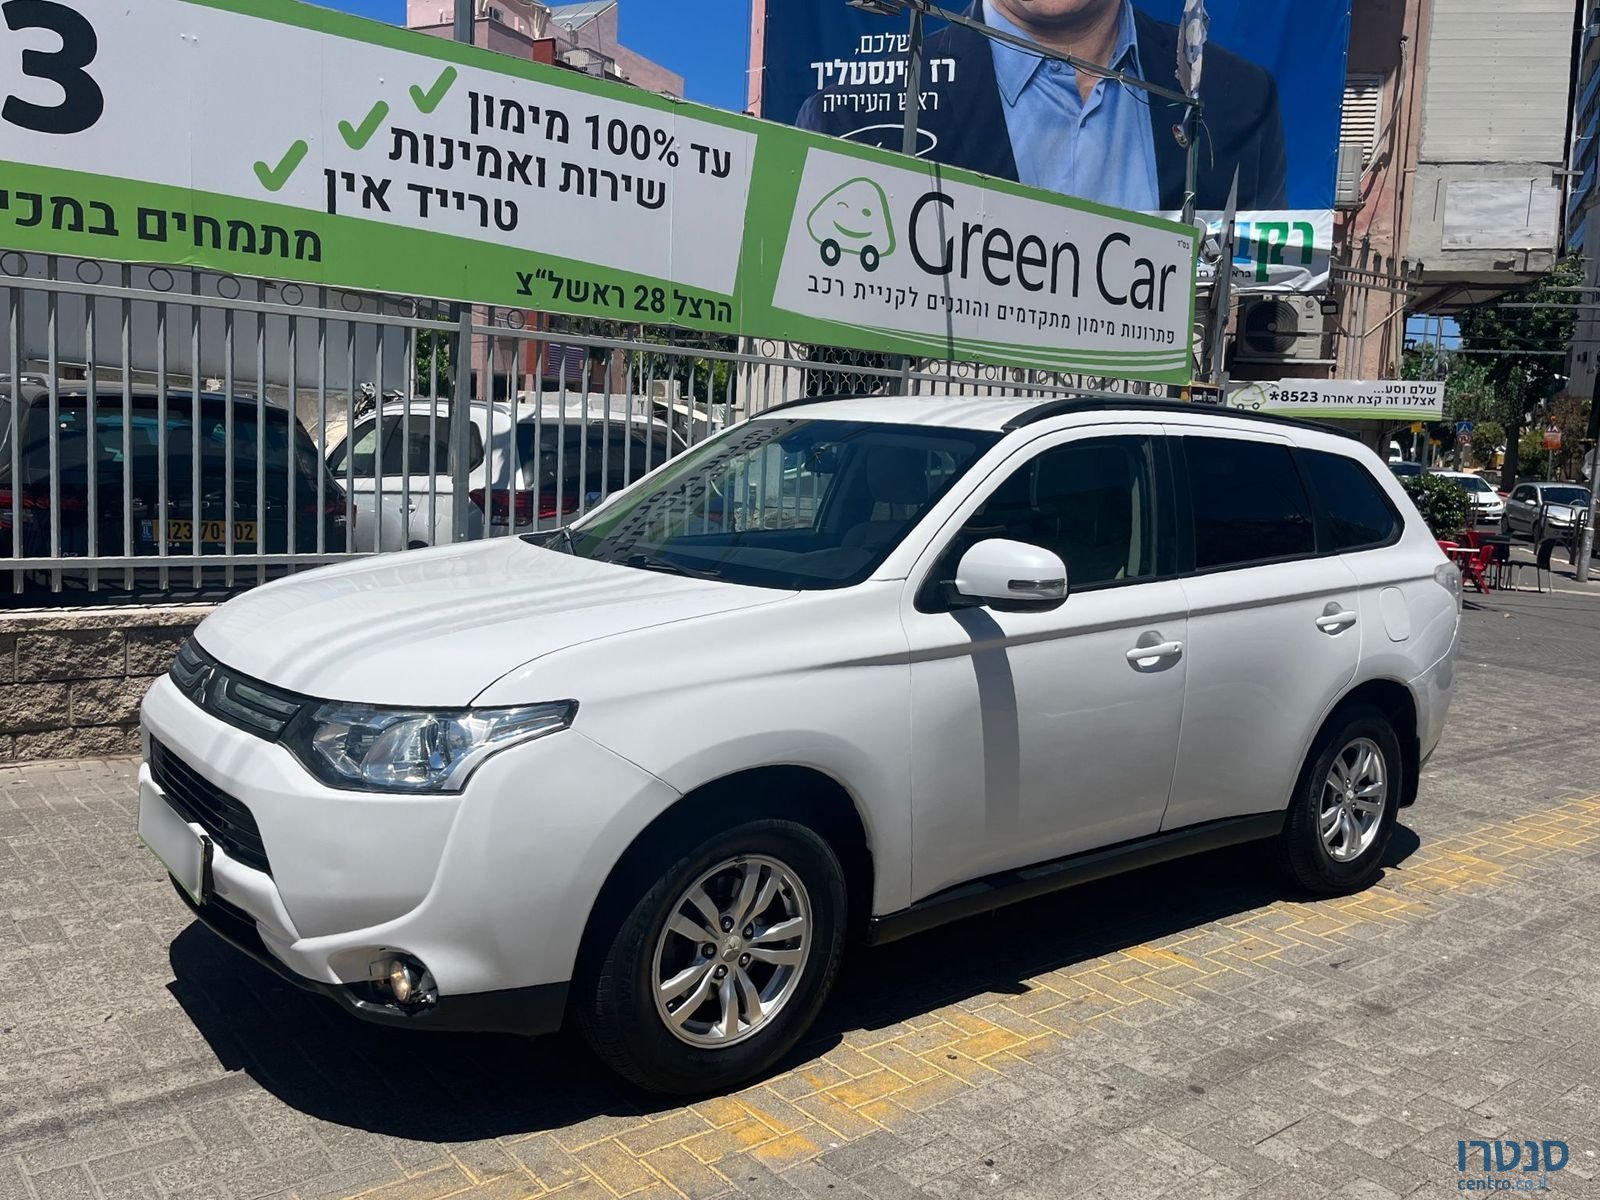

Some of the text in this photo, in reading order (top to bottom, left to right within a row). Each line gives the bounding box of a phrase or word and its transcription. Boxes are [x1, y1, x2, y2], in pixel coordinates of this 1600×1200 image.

[1, 0, 104, 134] 3
[810, 58, 956, 90] רז ינסטליך
[823, 93, 891, 113] העירייה
[468, 91, 731, 178] עד 100% מימון
[388, 126, 666, 210] שירות ואמינות
[324, 168, 518, 232] טרייד אין
[137, 206, 322, 263] מתמחים
[908, 191, 1080, 298] Green
[1096, 232, 1177, 312] Car
[633, 285, 665, 314] 28
[673, 290, 732, 323] הרצל
[807, 273, 1175, 344] פתרונות מימון מתקדמים והוגנים לקניית רכב
[1321, 394, 1354, 404] אחרת
[1357, 395, 1382, 407] קצת
[1385, 395, 1399, 405] זה
[1402, 395, 1436, 406] אצלנו
[1410, 384, 1437, 395] שלם
